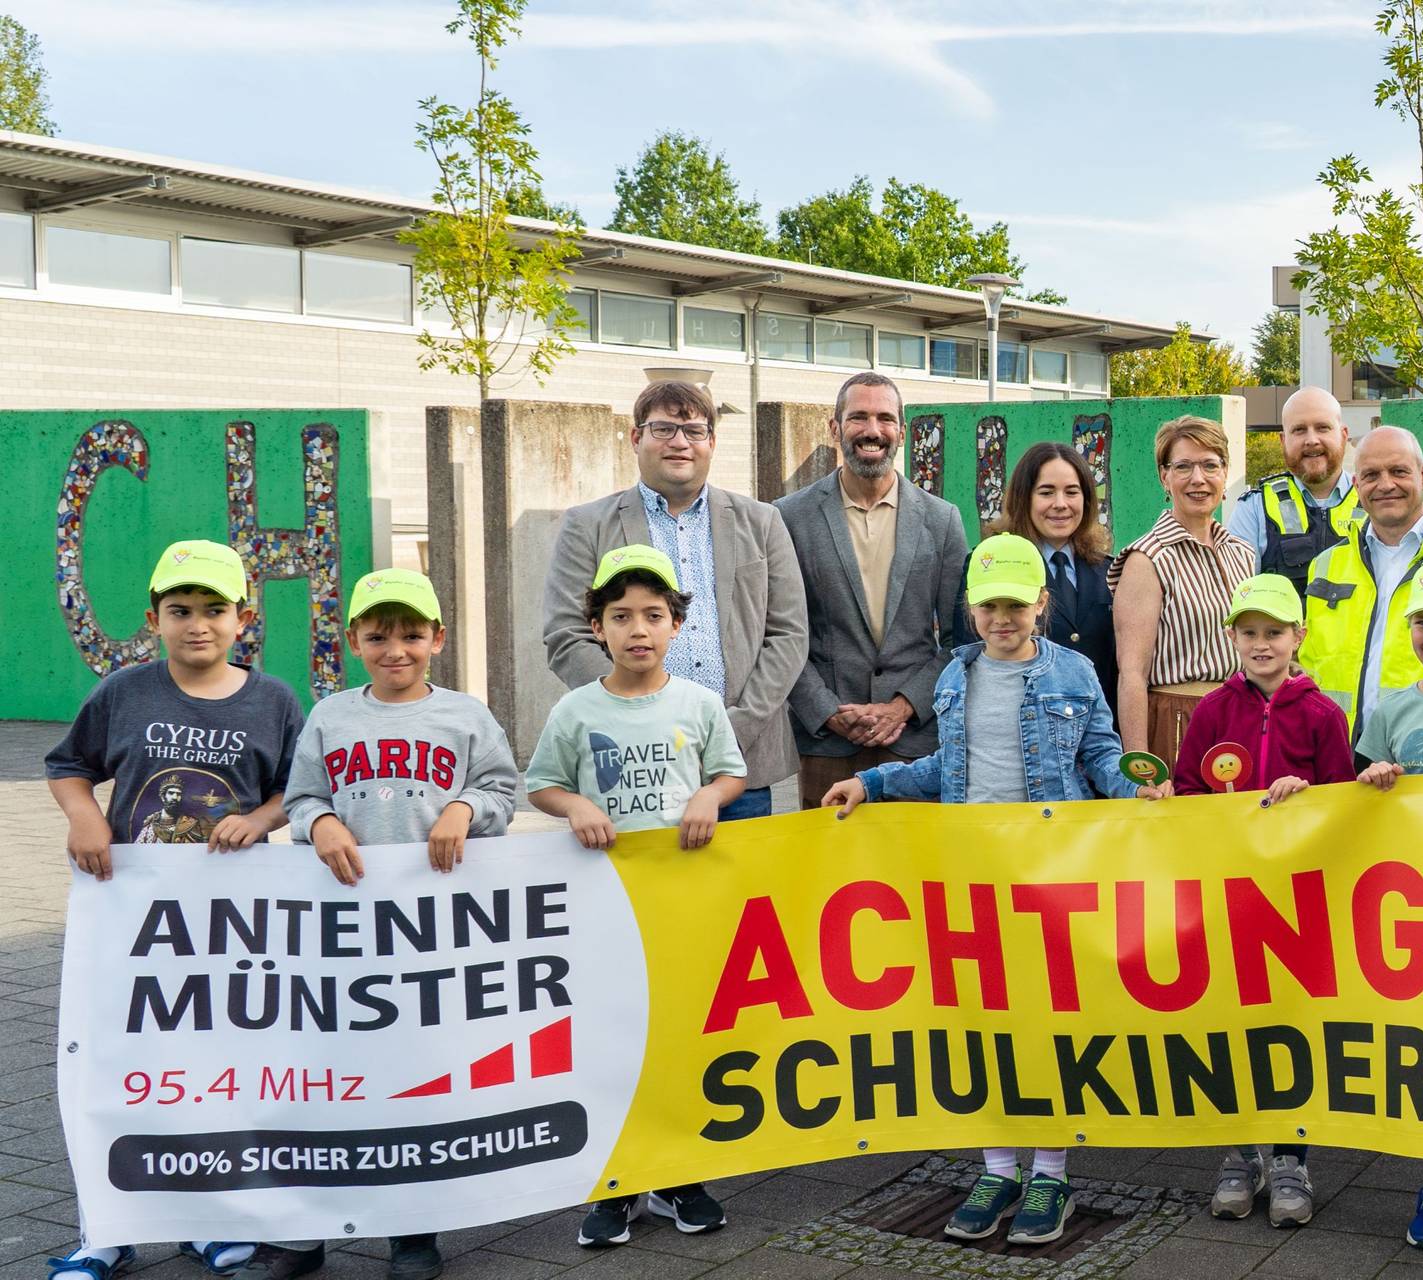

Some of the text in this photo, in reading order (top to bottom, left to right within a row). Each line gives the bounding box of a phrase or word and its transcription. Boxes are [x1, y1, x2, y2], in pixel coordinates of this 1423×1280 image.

[145, 745, 242, 766] THE GREAT
[146, 722, 247, 752] CYRUS
[595, 743, 676, 769] TRAVEL
[324, 739, 456, 794] PARIS
[620, 768, 667, 789] NEW
[129, 882, 571, 958] ANTENNE
[126, 955, 572, 1034] MÜNSTER
[123, 1066, 366, 1105] 95.4 MHz
[141, 1121, 561, 1176] 100% SICHER ZUR SCHULE.
